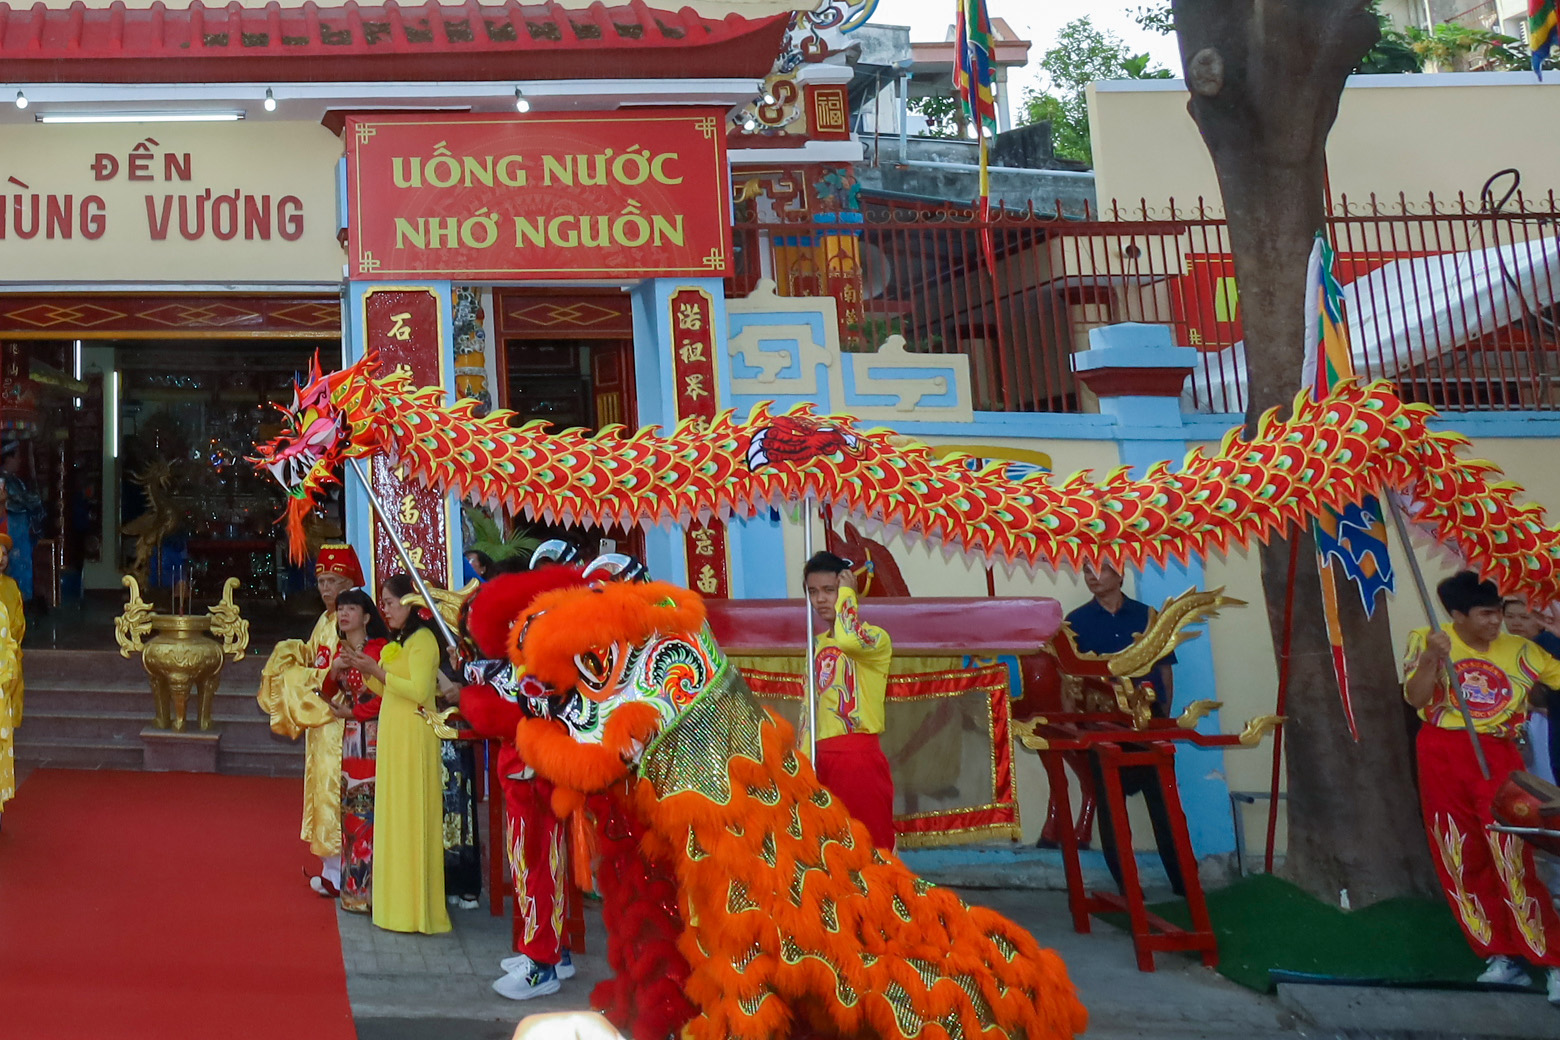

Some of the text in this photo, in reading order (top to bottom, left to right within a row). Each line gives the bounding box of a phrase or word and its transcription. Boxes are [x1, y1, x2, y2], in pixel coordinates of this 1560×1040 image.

[90, 137, 192, 182] ĐỀN
[391, 141, 684, 189] UỐNG NƯỚC
[145, 188, 305, 241] VƯƠNG
[395, 198, 684, 249] NHỚ NGUỒN
